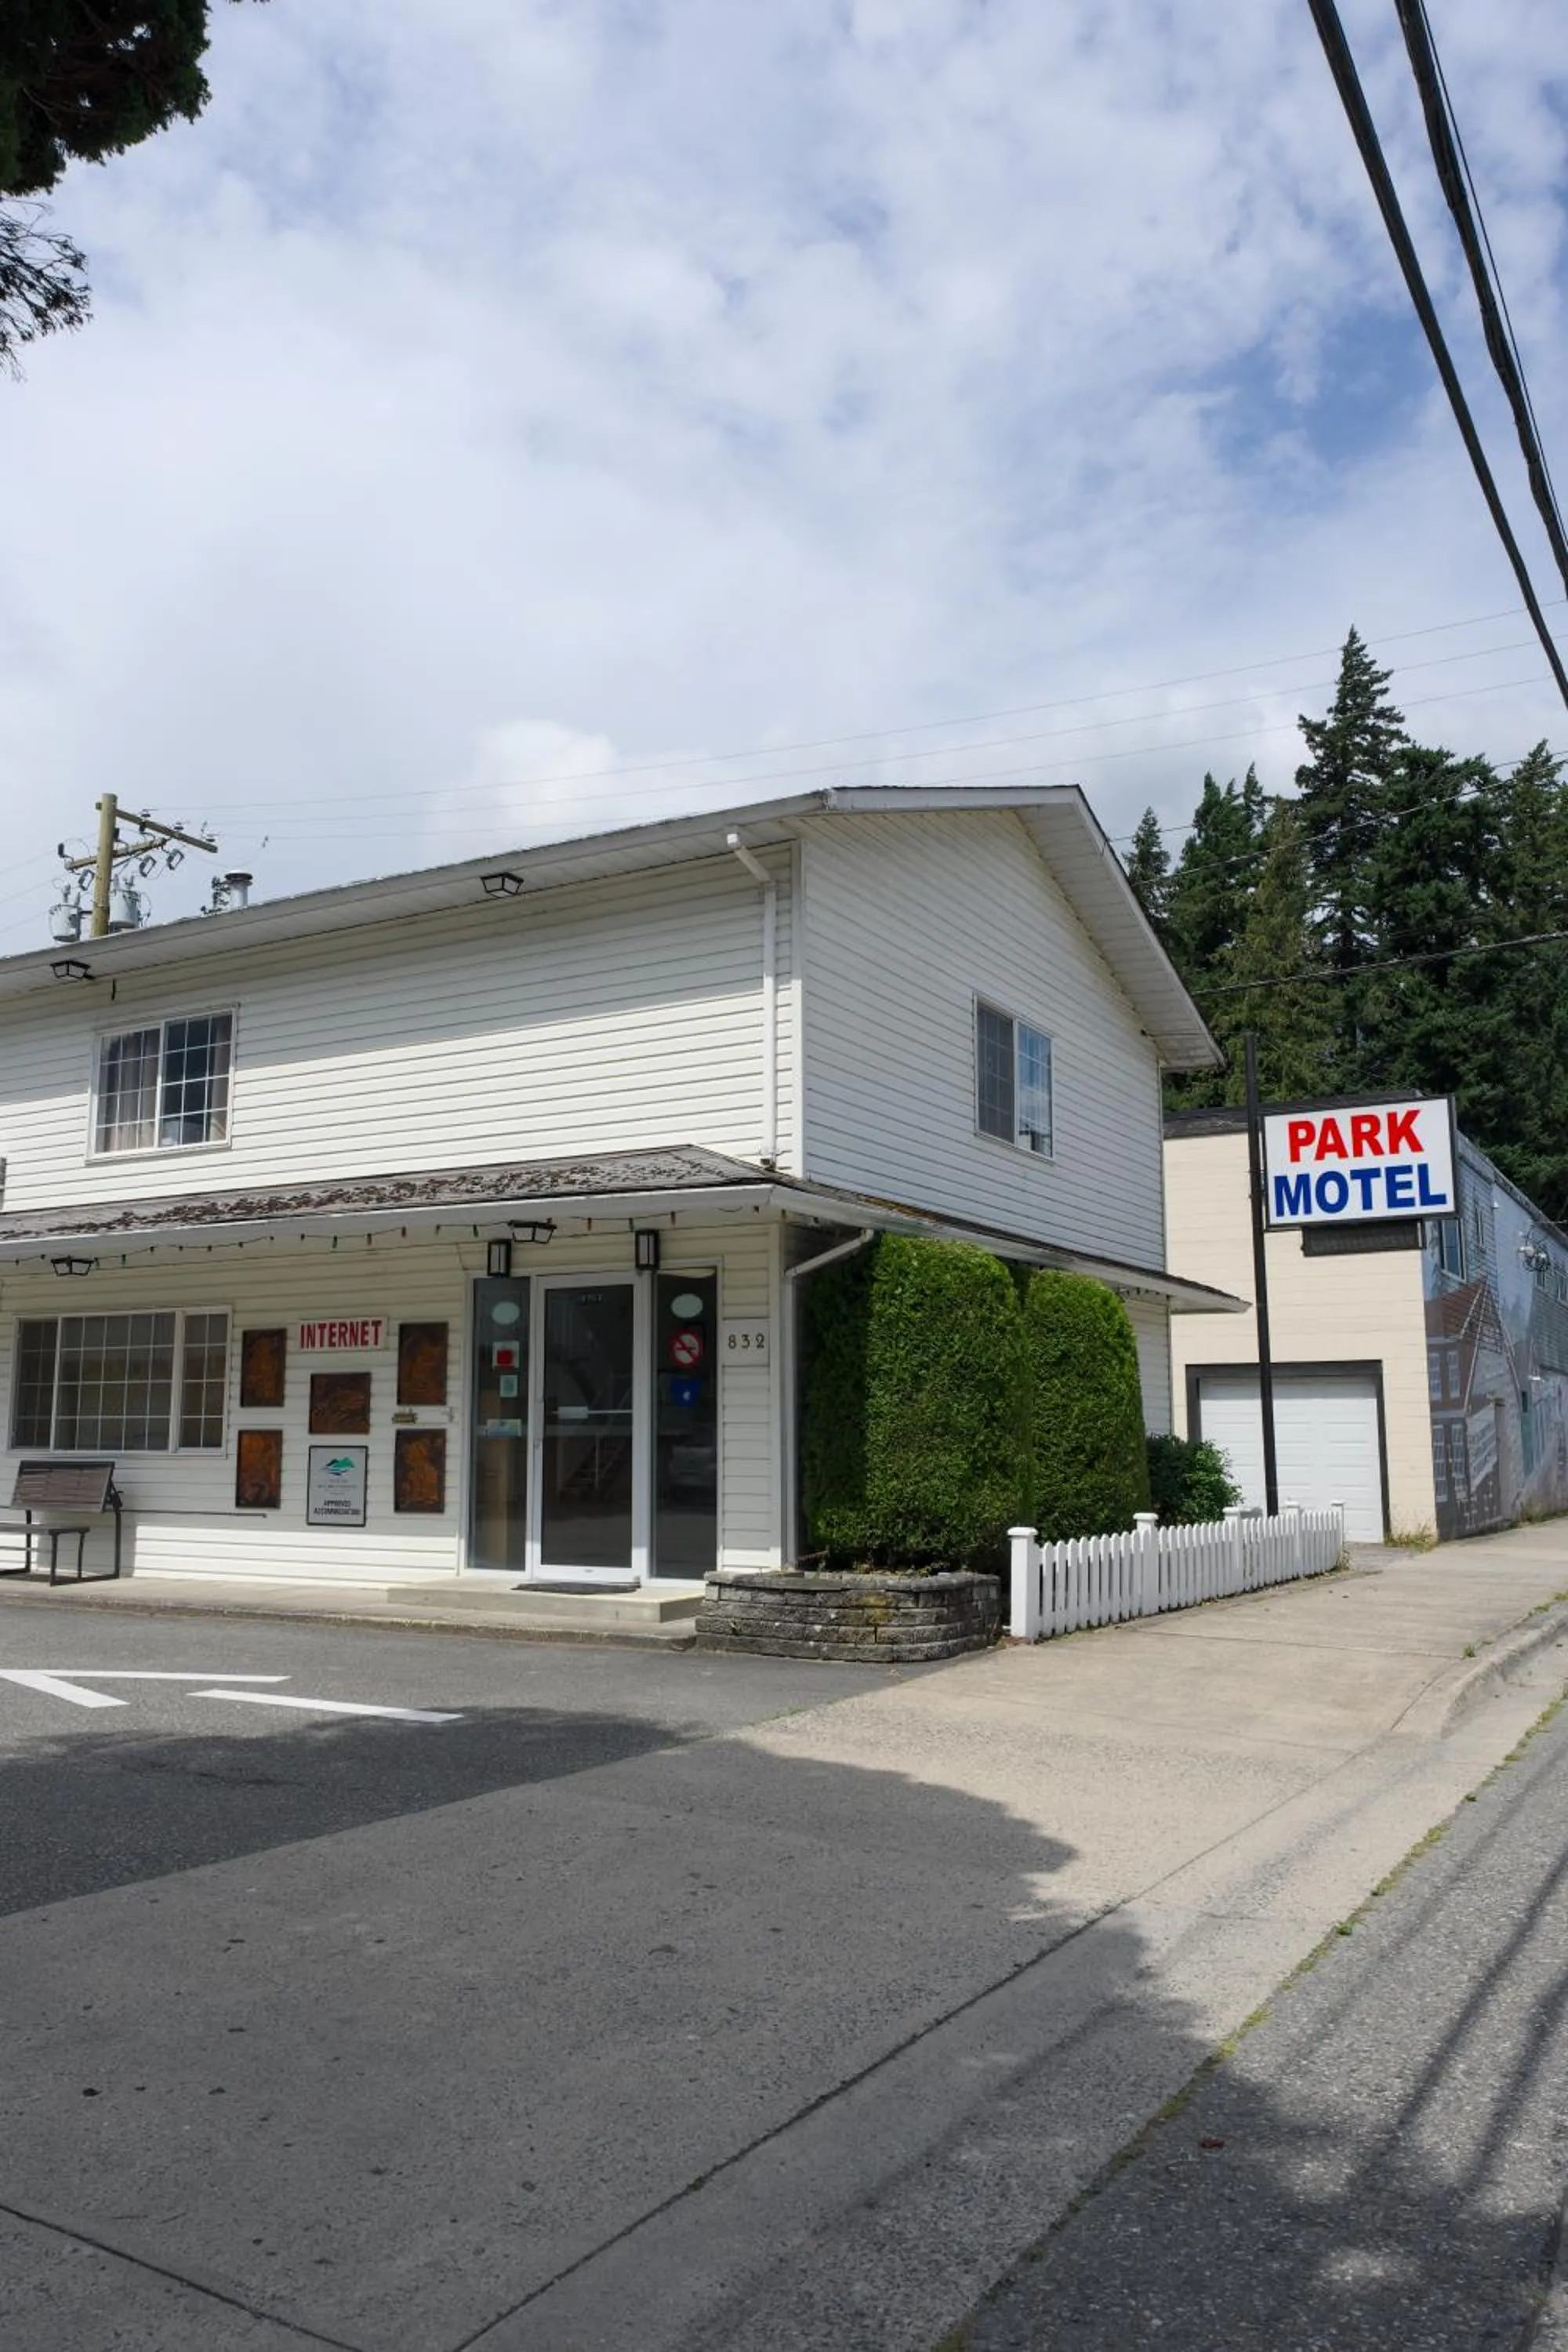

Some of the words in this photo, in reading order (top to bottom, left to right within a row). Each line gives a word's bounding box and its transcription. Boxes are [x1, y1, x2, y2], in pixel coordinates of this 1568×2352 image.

[1287, 1109, 1425, 1163] PARK
[1274, 1163, 1447, 1218] MOTEL
[300, 1320, 382, 1348] INTERNET
[728, 1333, 765, 1349] 832
